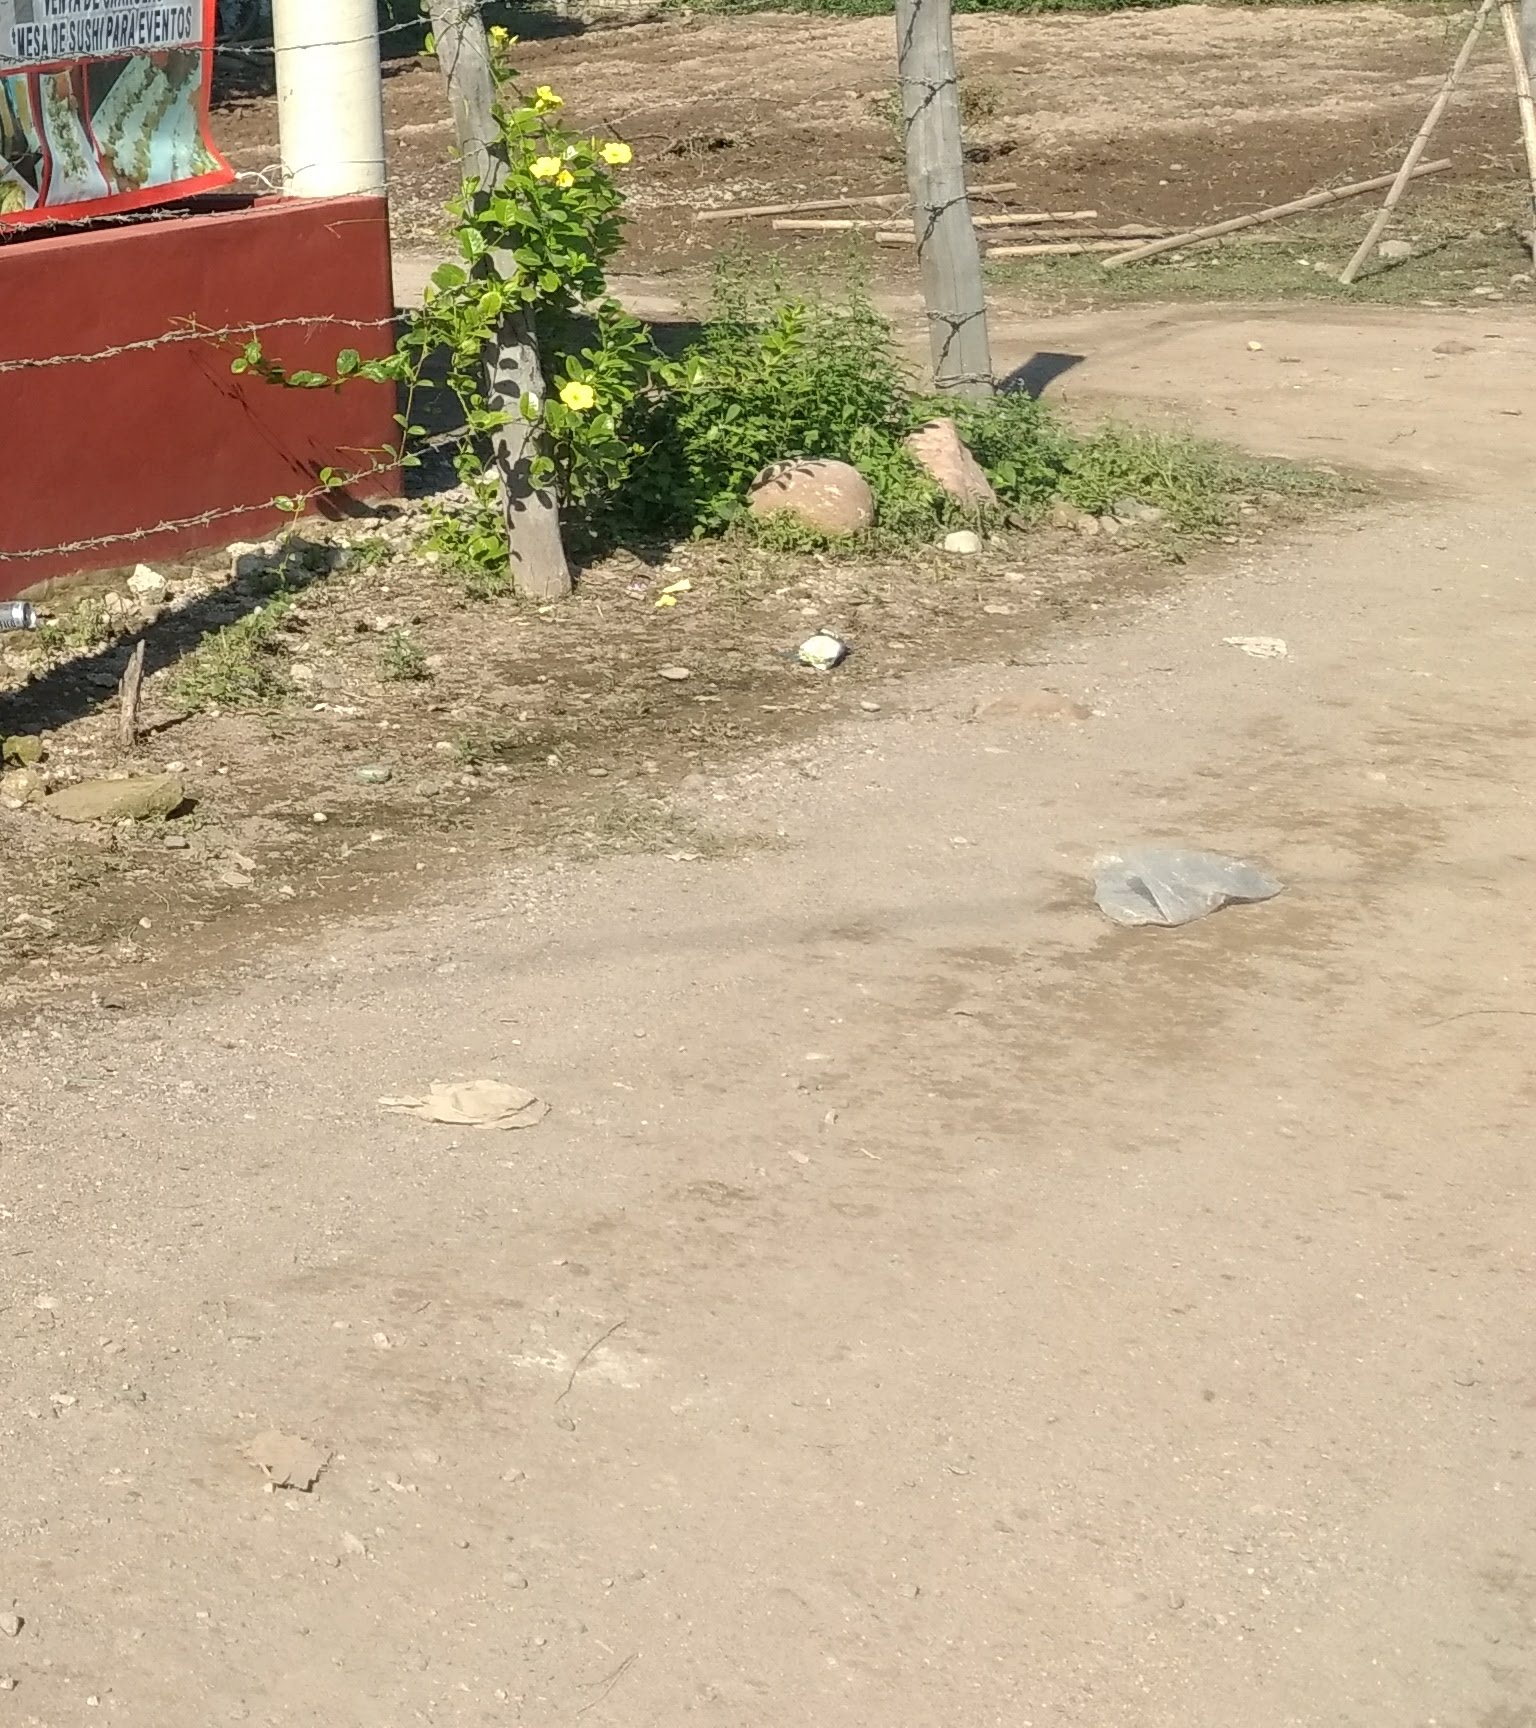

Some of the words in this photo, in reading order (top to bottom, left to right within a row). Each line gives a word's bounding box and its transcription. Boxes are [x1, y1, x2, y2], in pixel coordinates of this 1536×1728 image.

[51, 22, 65, 53] DE
[69, 18, 103, 52] SUSHI
[105, 13, 135, 48] PARA
[138, 6, 193, 44] EVENTOS
